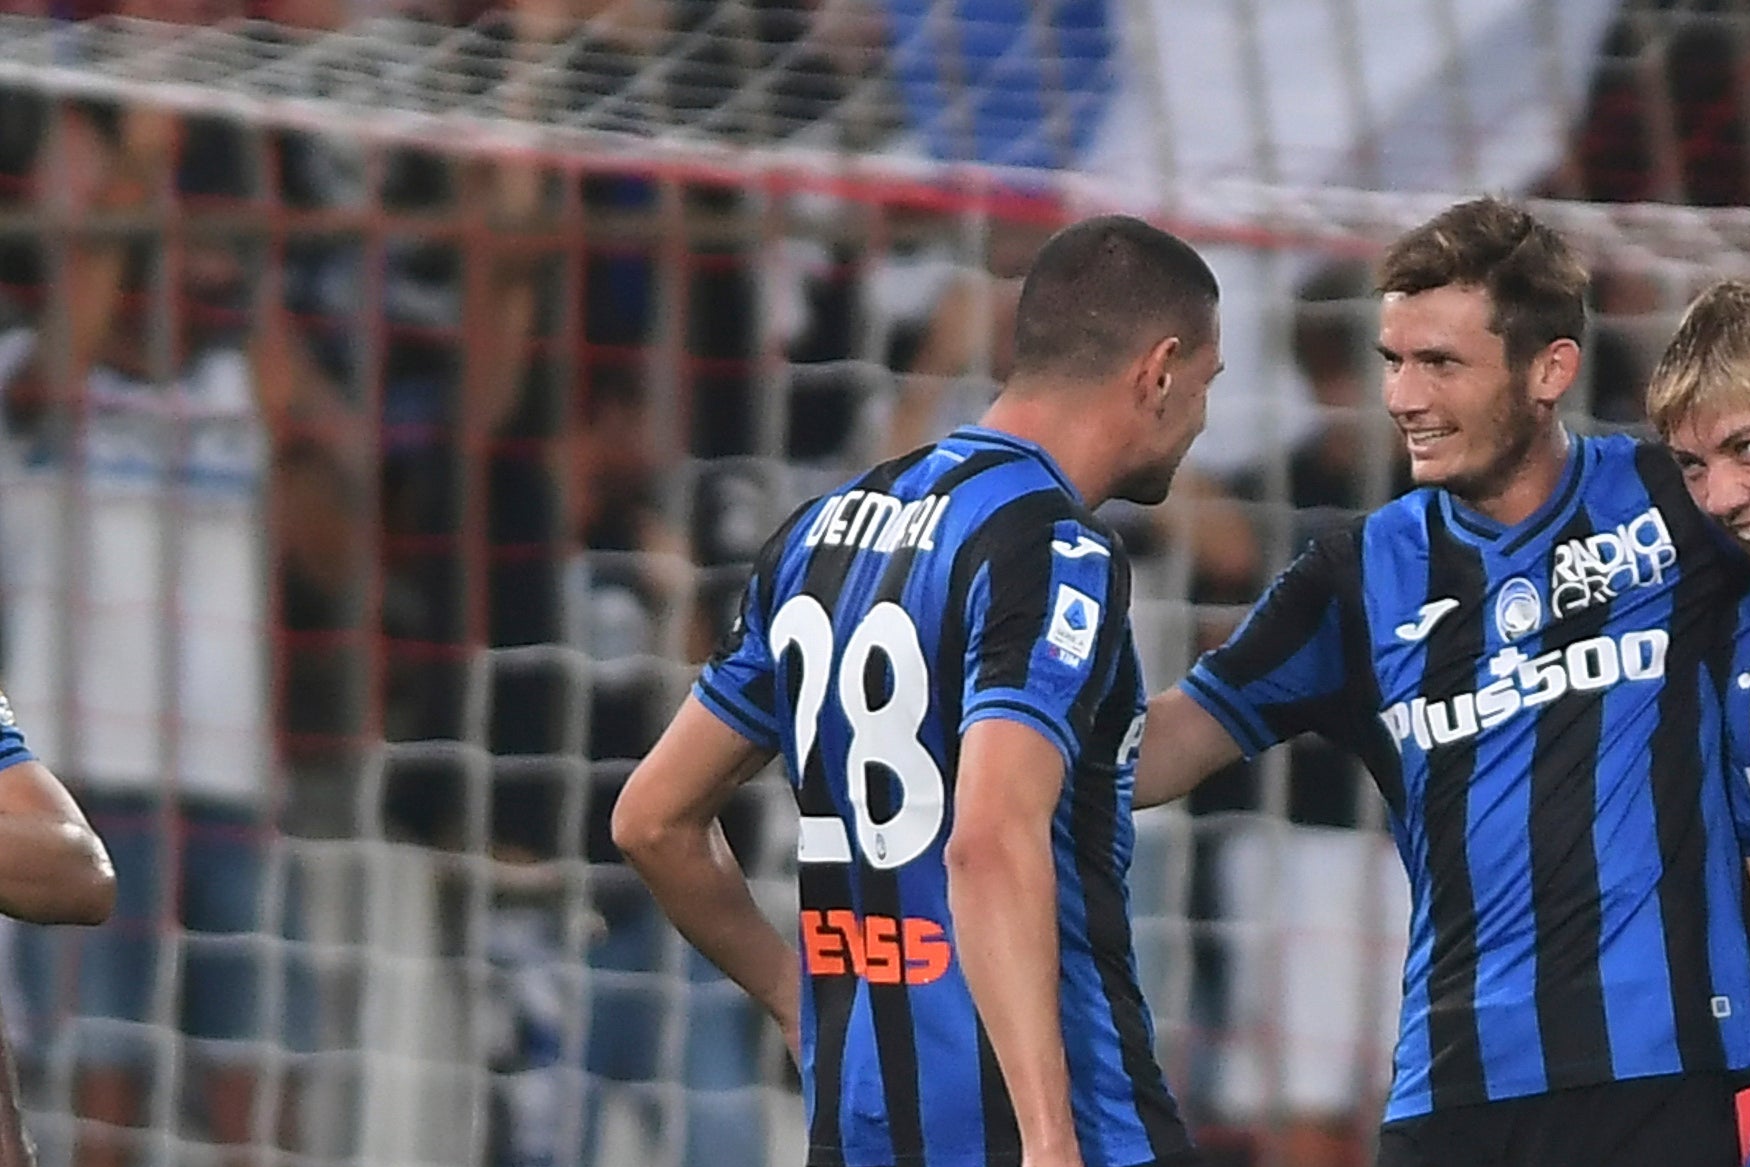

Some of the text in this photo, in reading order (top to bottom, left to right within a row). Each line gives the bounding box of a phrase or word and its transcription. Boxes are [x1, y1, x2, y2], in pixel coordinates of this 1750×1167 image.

[1552, 507, 1672, 590] RADICI
[770, 595, 944, 869] 28
[1379, 629, 1669, 754] Plus500
